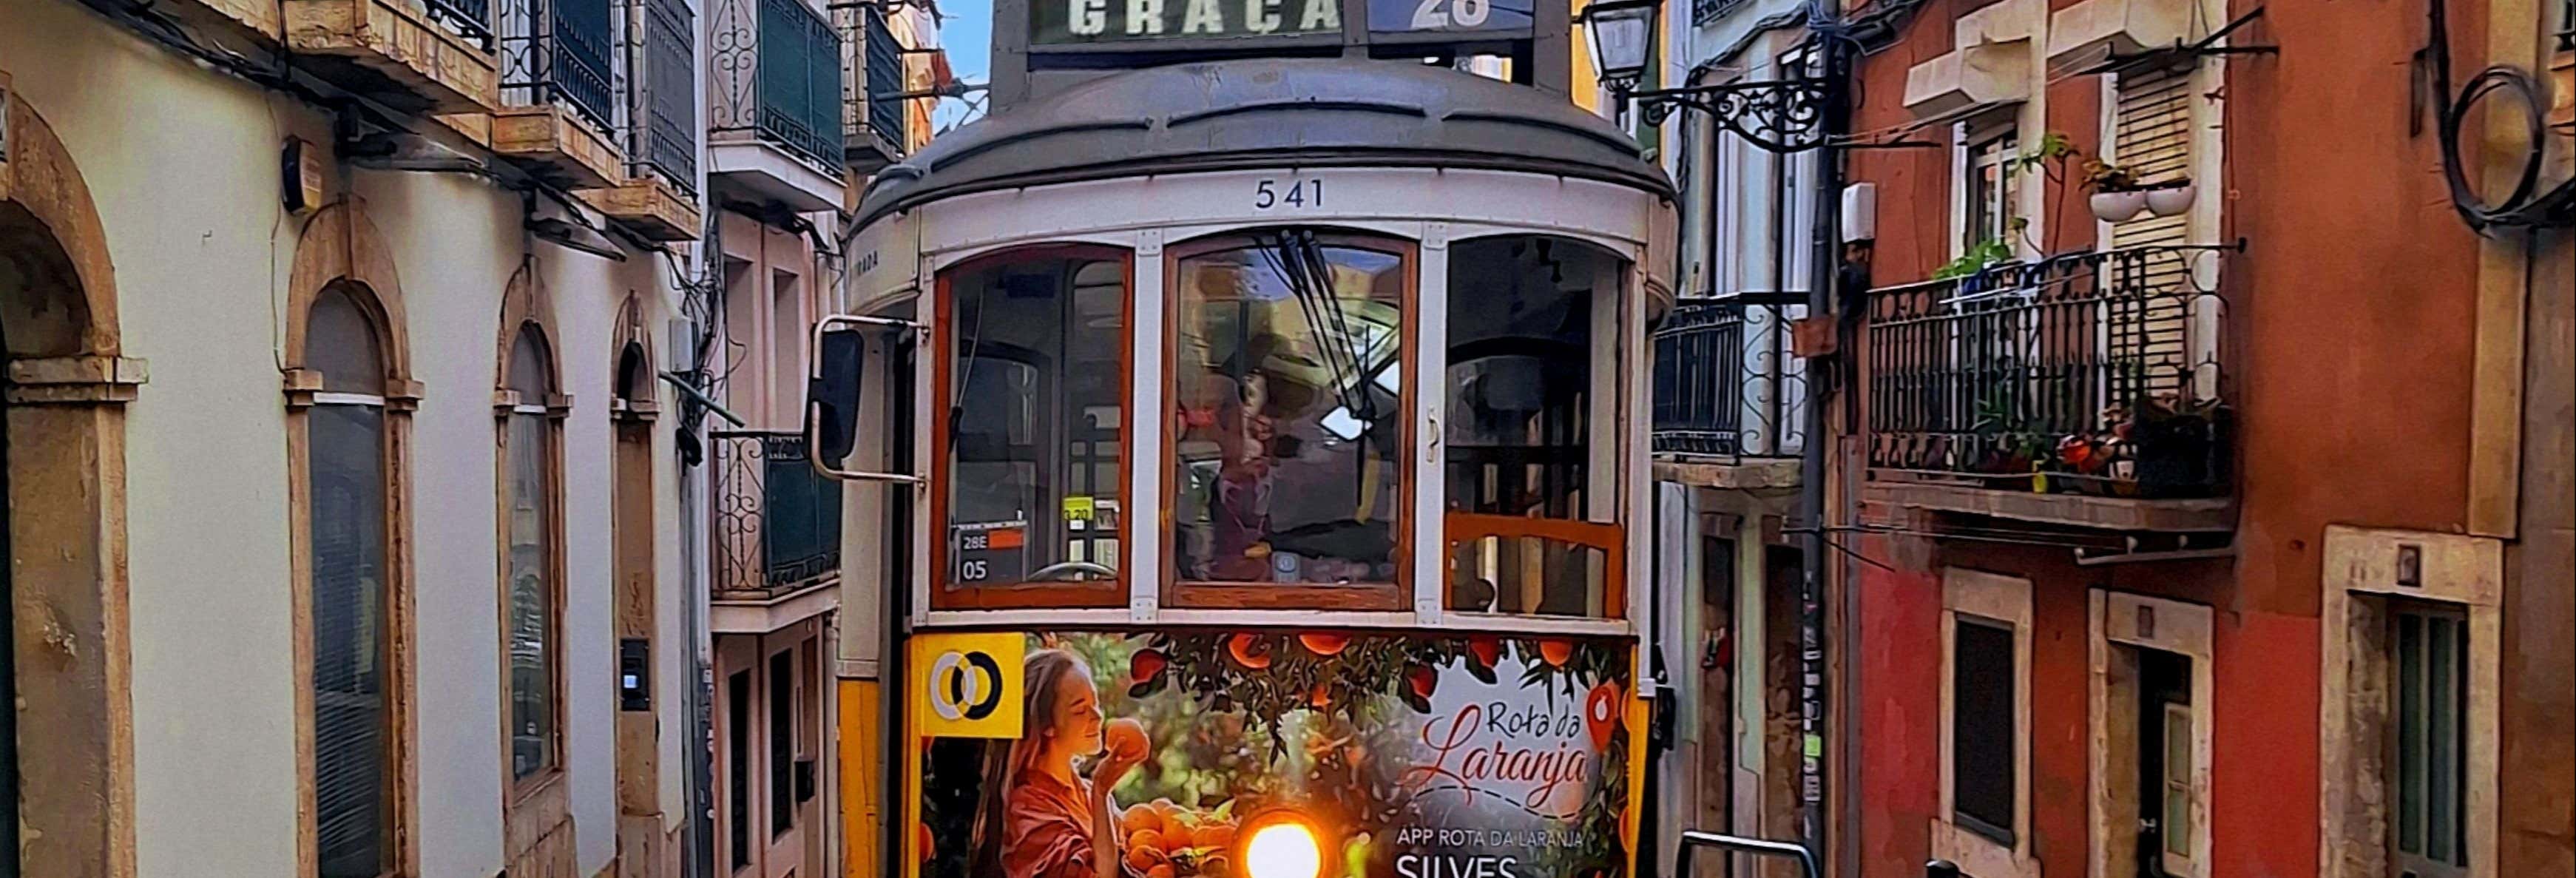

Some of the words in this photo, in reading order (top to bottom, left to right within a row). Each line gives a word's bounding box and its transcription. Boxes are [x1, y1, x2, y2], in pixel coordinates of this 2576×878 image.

[1256, 180, 1321, 208] 541
[964, 536, 987, 550] 28E
[963, 561, 987, 580] 05
[1487, 701, 1549, 738] Rota
[1555, 703, 1581, 738] da
[1396, 704, 1589, 808] Laranja
[1396, 828, 1434, 845] APP
[1439, 829, 1486, 846] ROTA
[1490, 831, 1514, 846] DA
[1518, 830, 1583, 847] LARANJA
